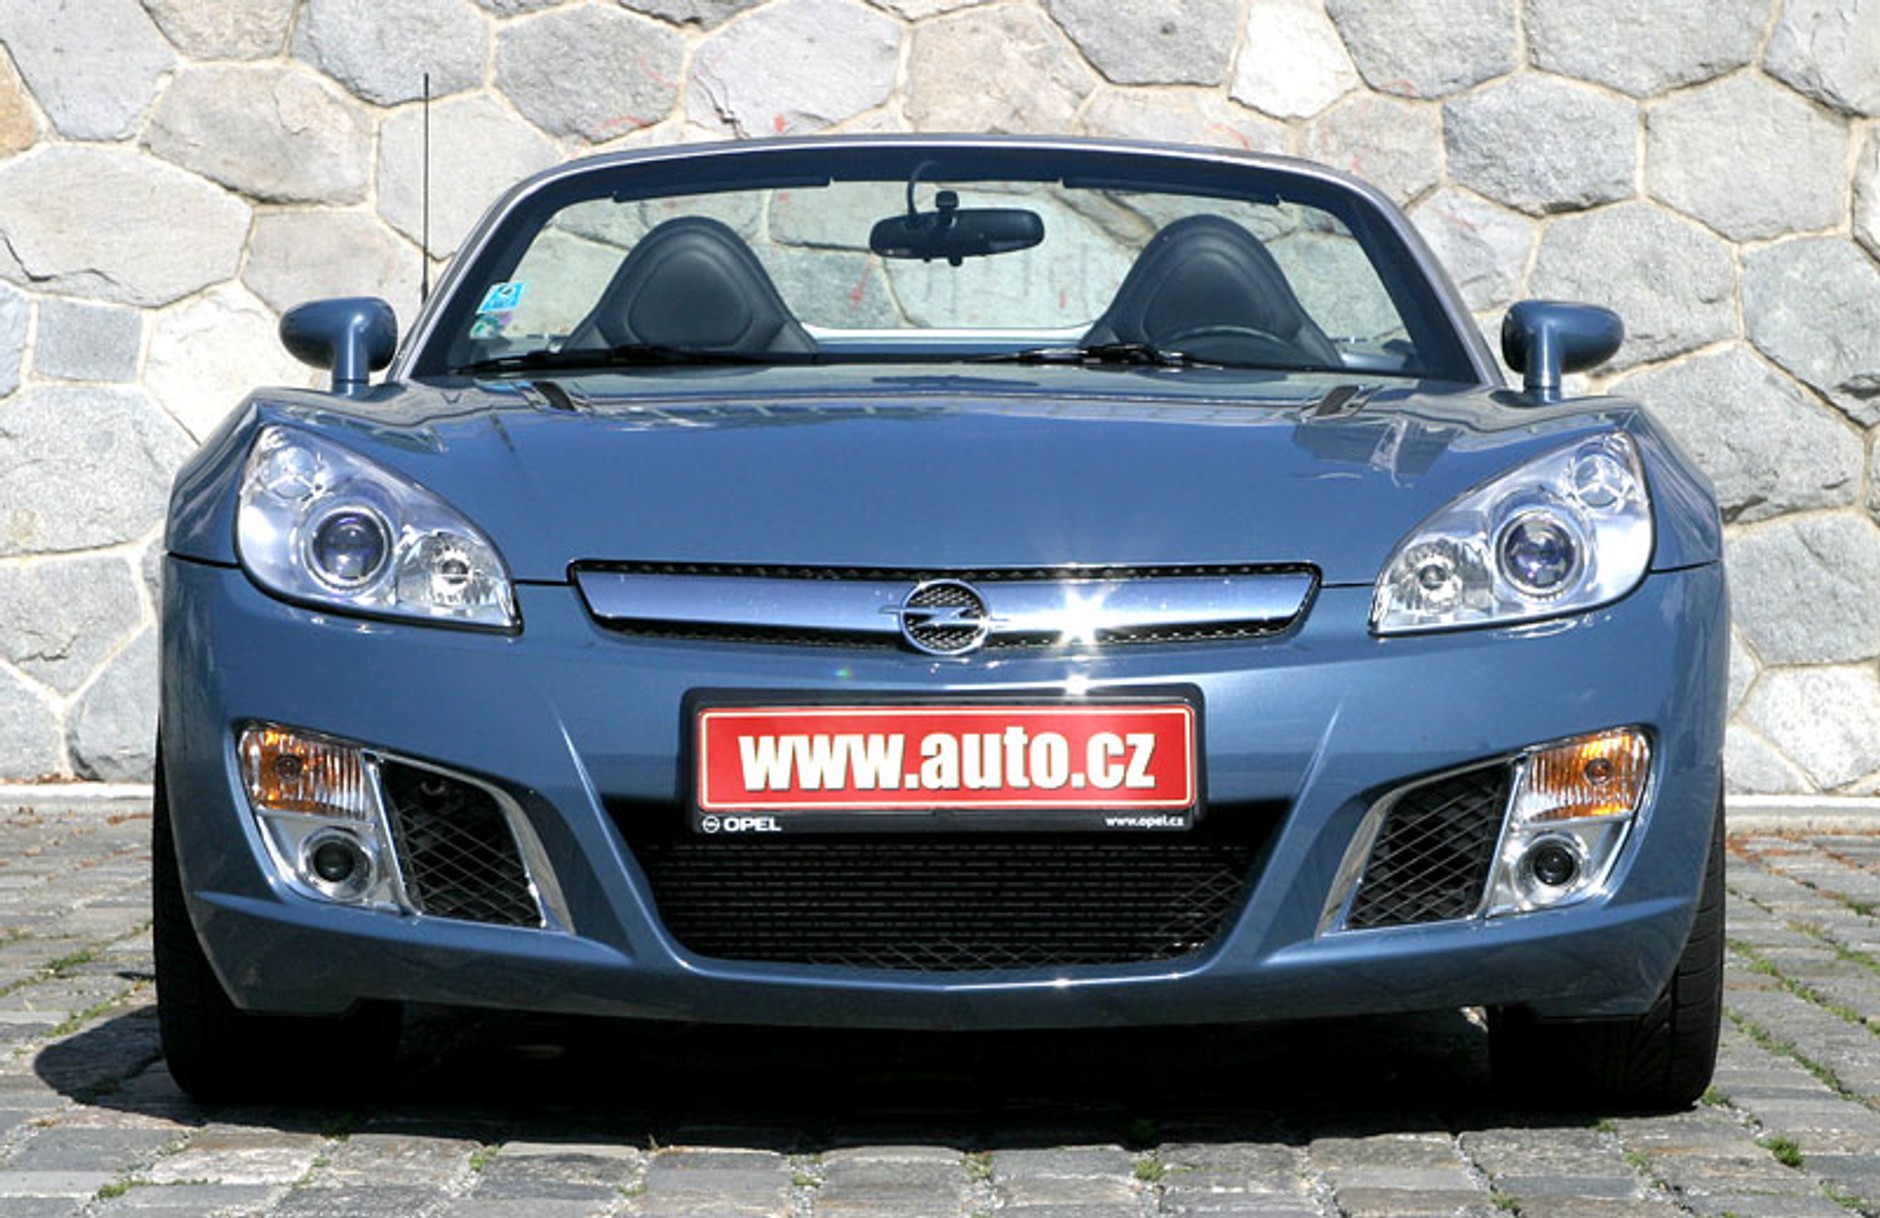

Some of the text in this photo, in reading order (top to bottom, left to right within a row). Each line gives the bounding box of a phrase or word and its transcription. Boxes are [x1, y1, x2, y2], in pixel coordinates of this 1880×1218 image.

[738, 725, 1156, 791] www.auto.cz
[723, 816, 782, 832] OPEL
[1105, 814, 1185, 828] www.opel.cz
